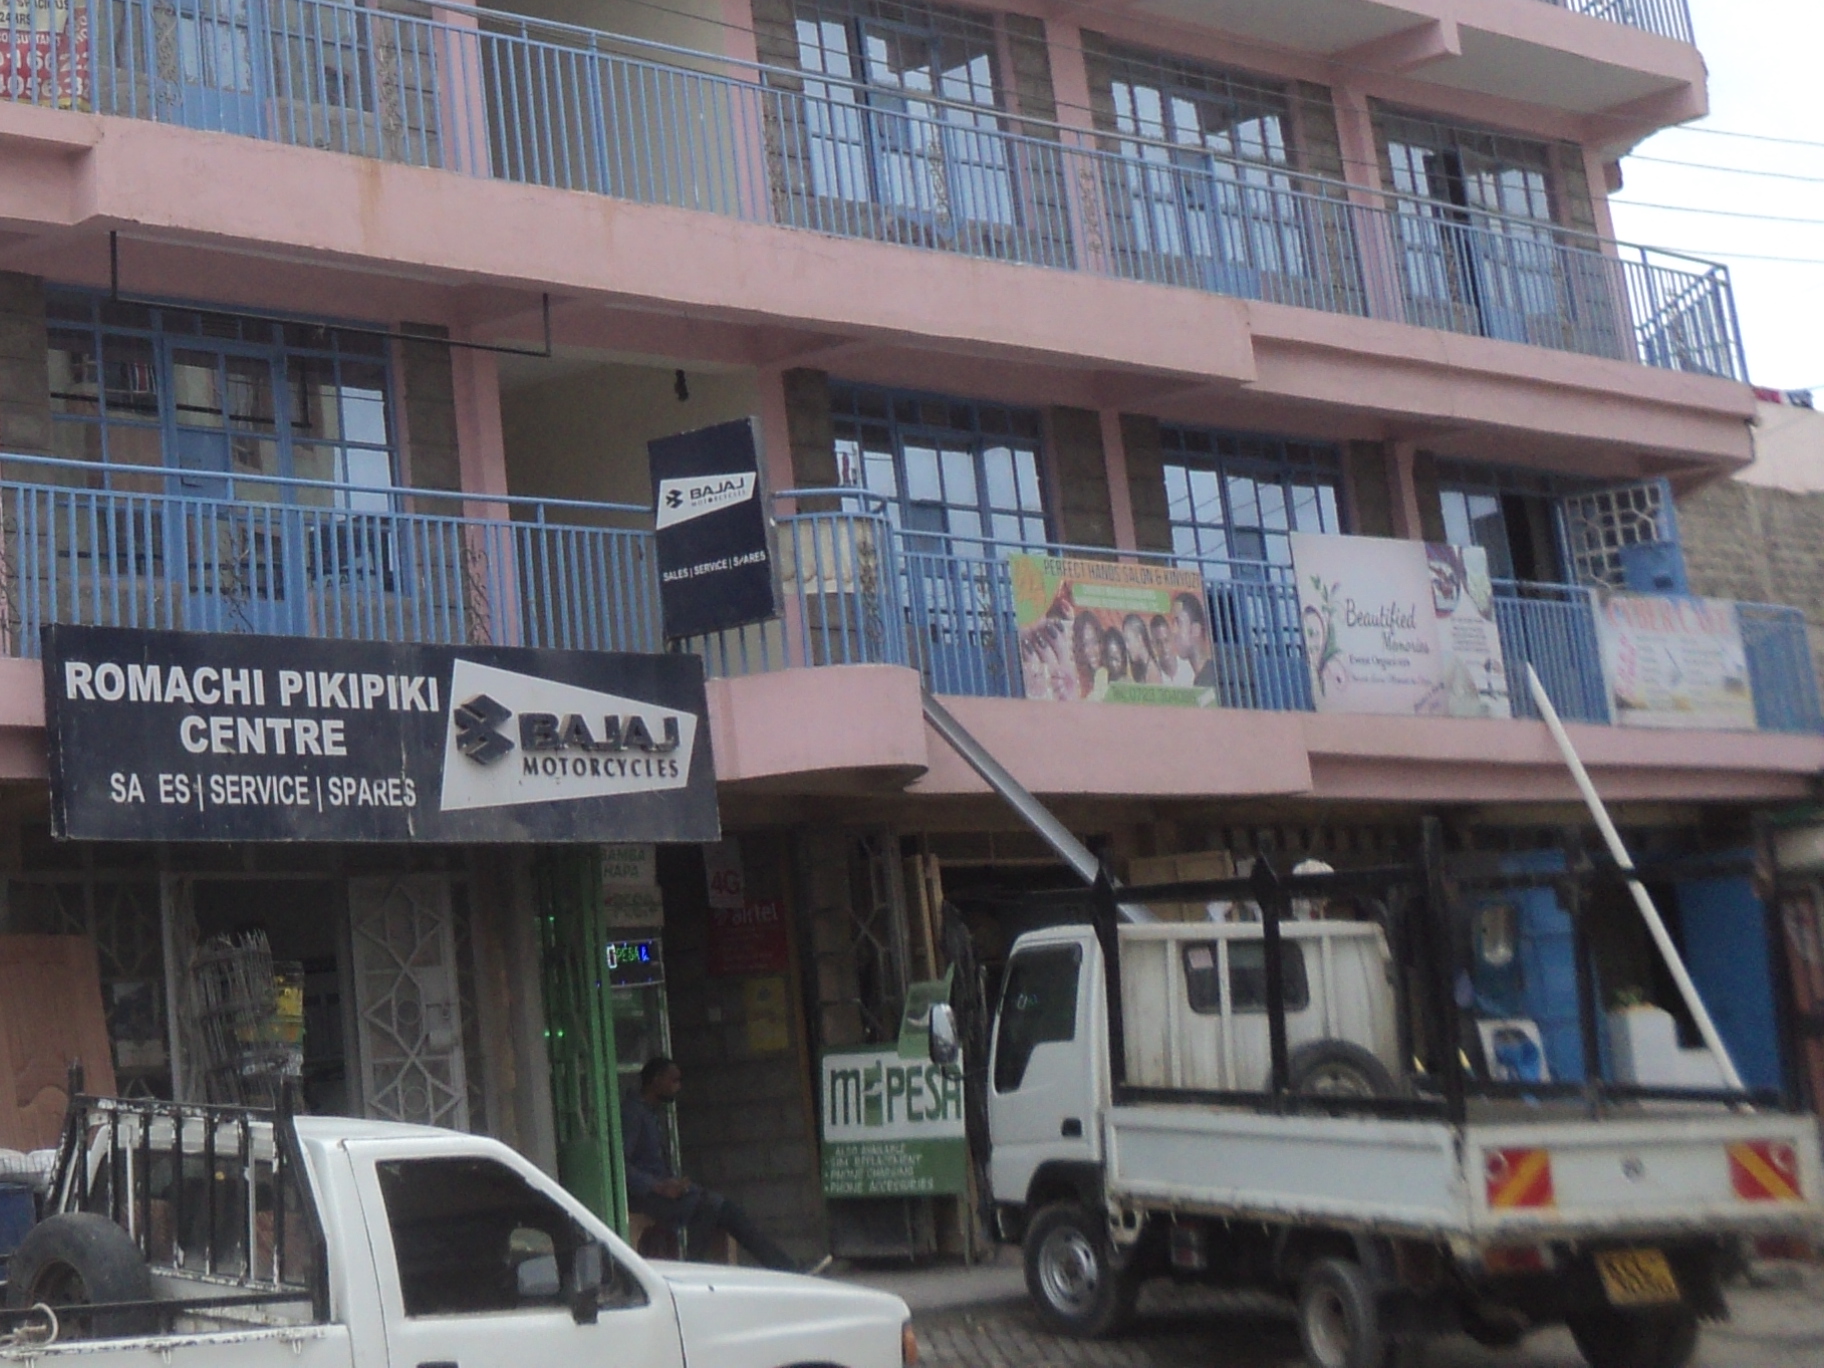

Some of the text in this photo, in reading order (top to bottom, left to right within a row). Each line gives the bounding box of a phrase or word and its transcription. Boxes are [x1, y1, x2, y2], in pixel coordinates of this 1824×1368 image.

[690, 476, 744, 500] BAJAJ
[663, 567, 689, 582] SALES
[694, 558, 728, 575] SERVICE
[1044, 558, 1085, 579] PERFECT
[1089, 564, 1121, 582] HANDS
[1125, 566, 1154, 585] SALON
[1346, 598, 1416, 635] Beautified
[65, 662, 440, 712] ROMACHI PIKIPIKI
[180, 716, 347, 757] CENTRE
[518, 712, 680, 753] BAJAJ
[523, 757, 679, 779] MOTORCYCLES
[110, 773, 417, 808] SAES SERVICE SPARES
[711, 869, 742, 896] 4G
[731, 902, 778, 926] airtel
